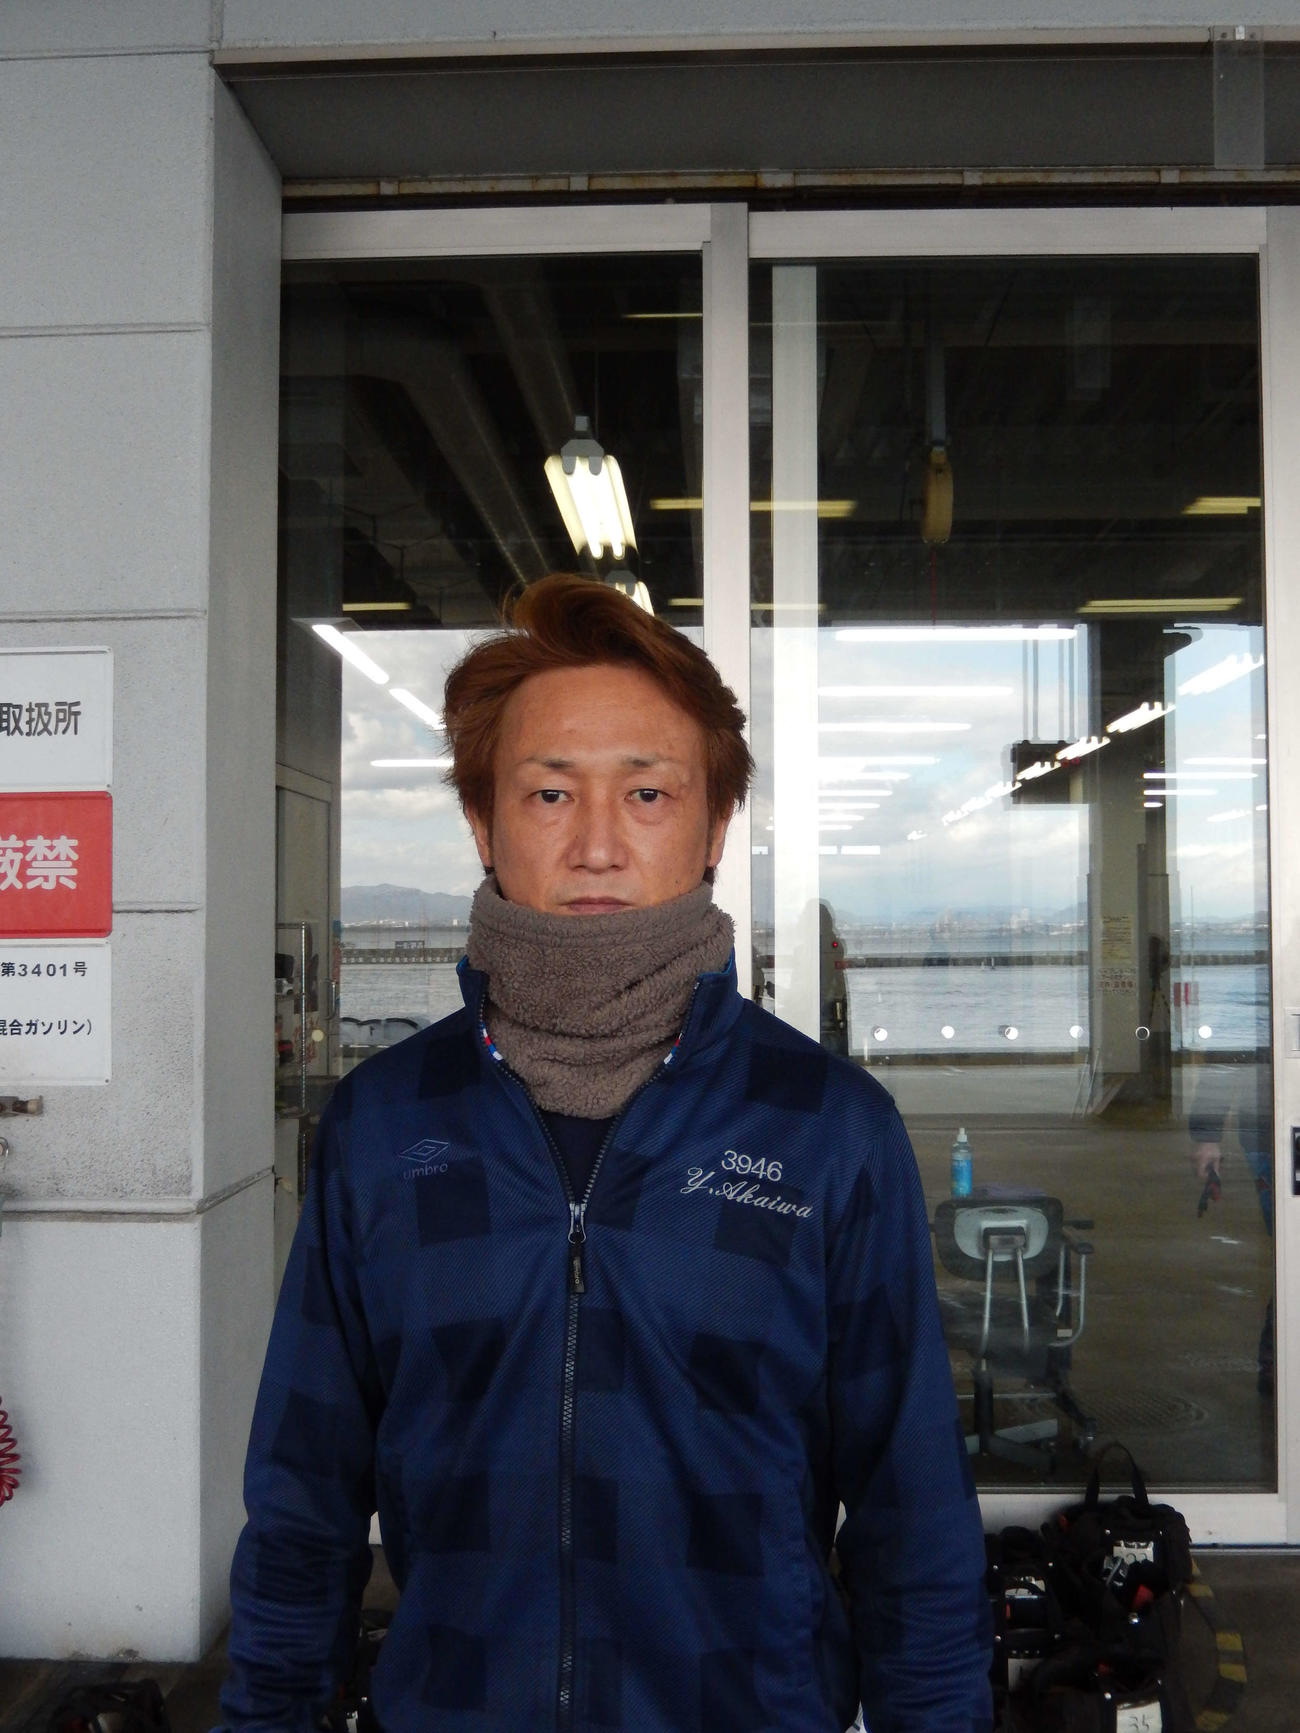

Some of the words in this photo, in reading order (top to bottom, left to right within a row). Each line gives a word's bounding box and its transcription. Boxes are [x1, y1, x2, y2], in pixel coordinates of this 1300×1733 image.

[0, 701, 82, 736] 取扱所
[0, 961, 88, 977] 第3401号
[402, 1163, 449, 1180] umbro
[721, 1150, 783, 1182] 3946
